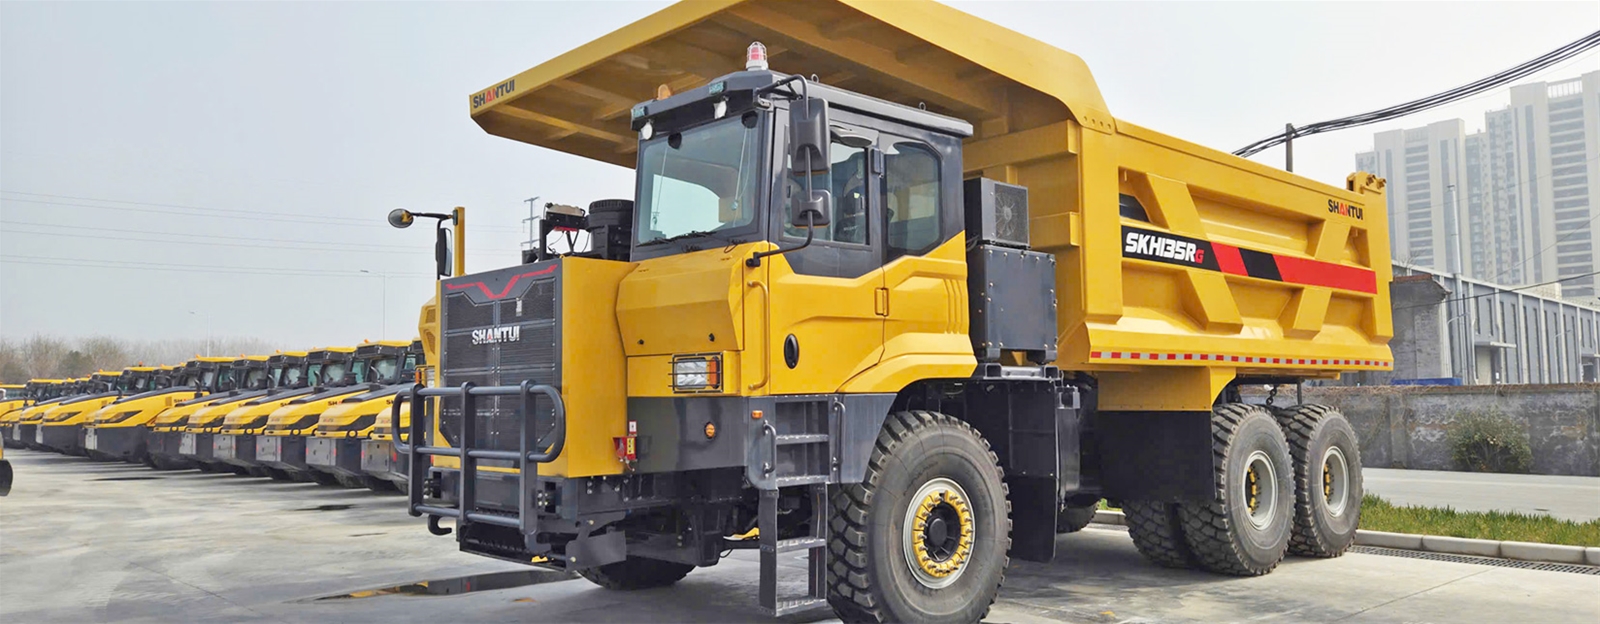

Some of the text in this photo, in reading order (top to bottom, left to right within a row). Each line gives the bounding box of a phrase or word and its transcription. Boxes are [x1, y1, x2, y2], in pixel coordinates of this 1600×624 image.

[473, 79, 515, 109] SHANTUI
[1328, 199, 1363, 220] SHANTUI
[472, 325, 520, 345] SHANTUI
